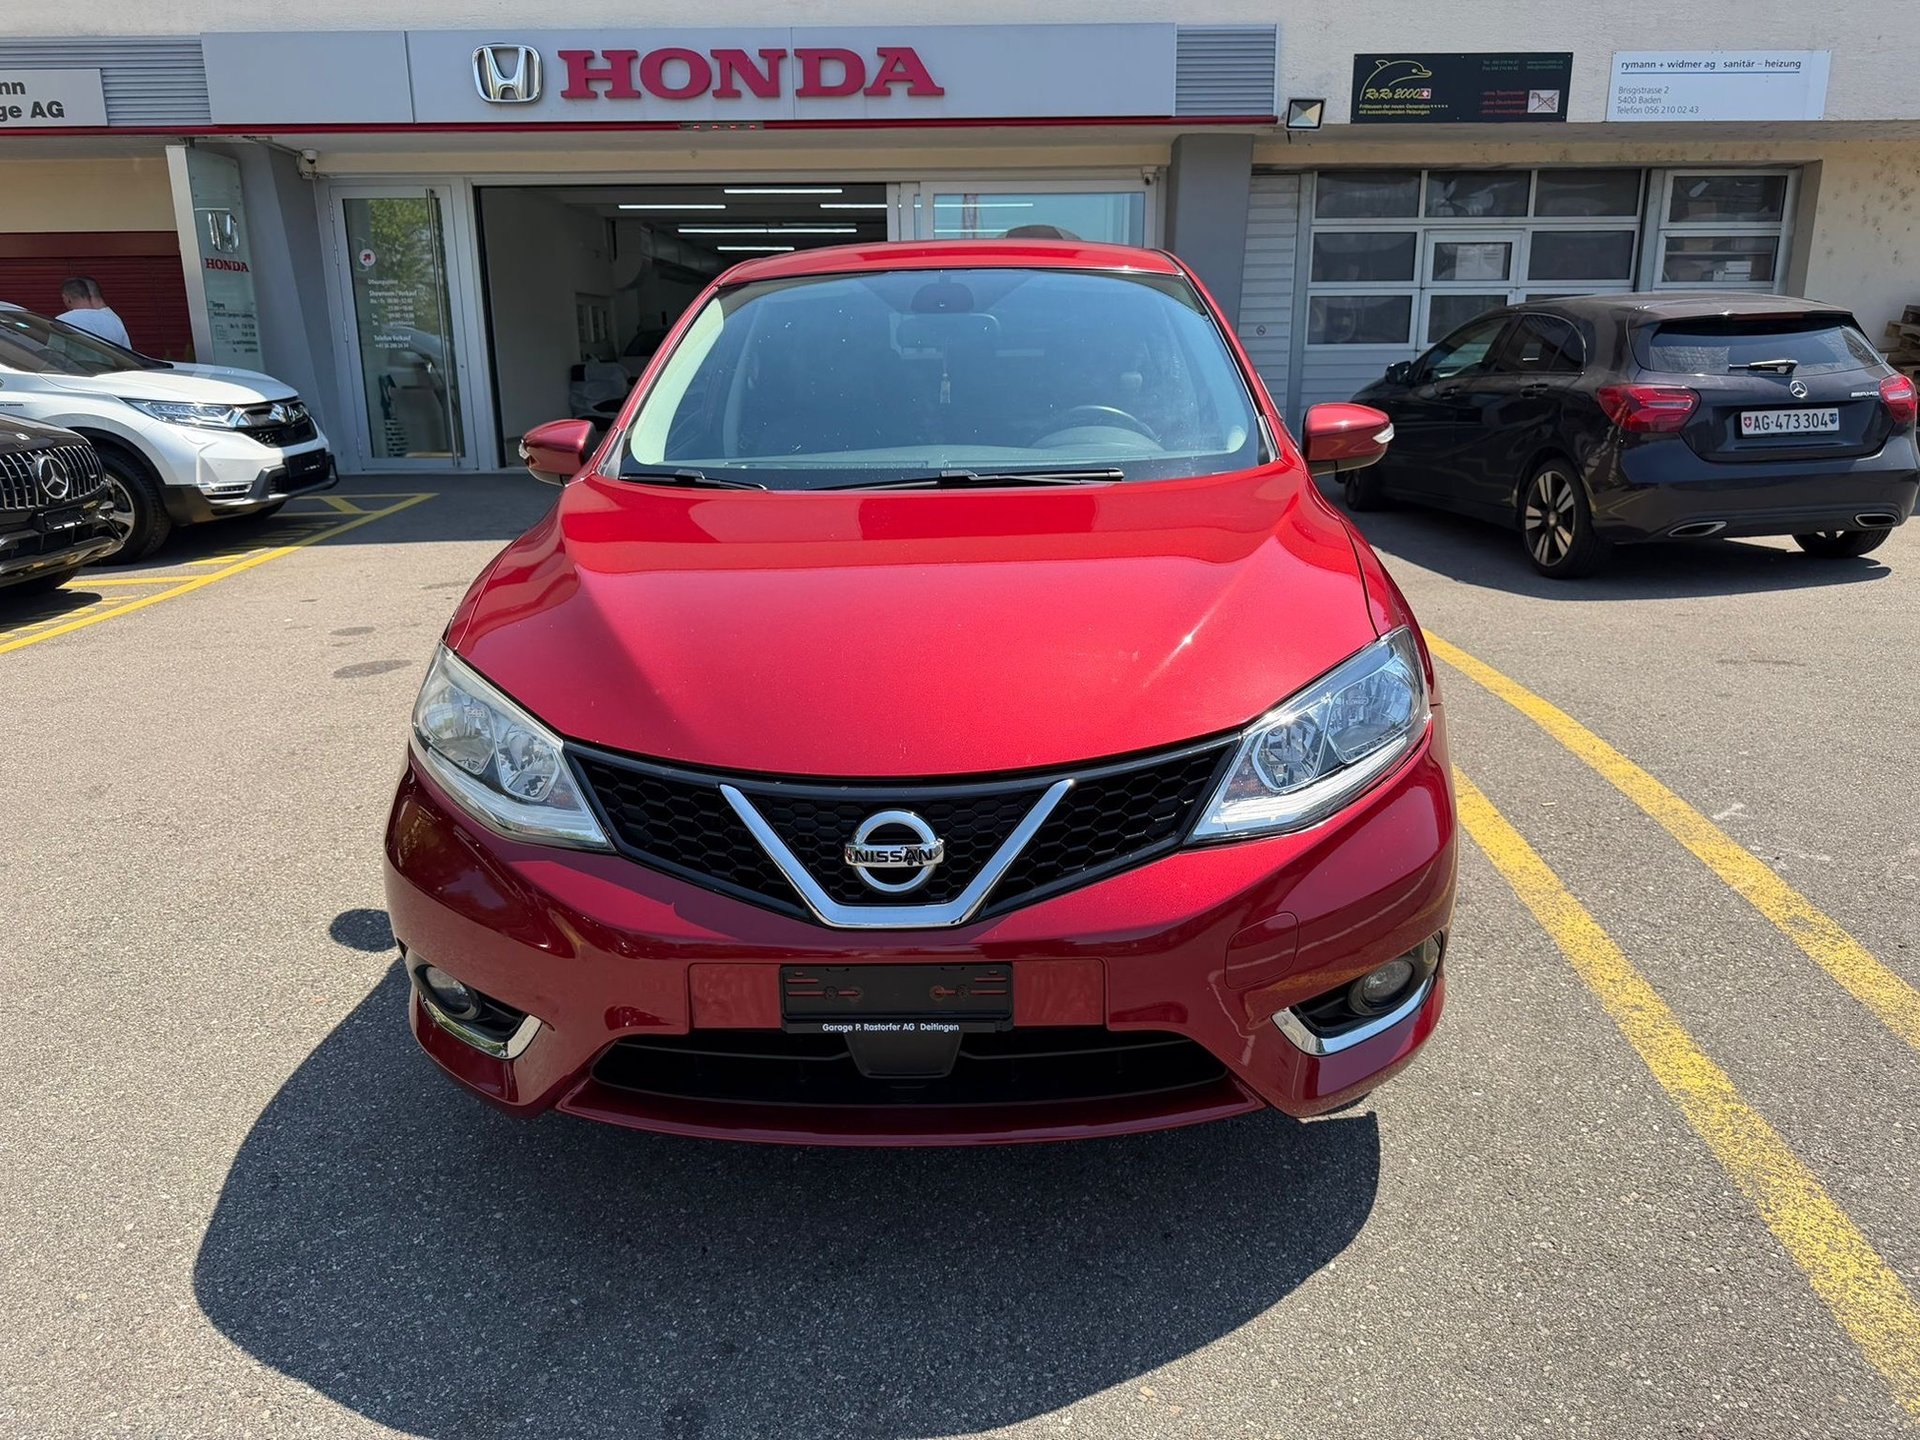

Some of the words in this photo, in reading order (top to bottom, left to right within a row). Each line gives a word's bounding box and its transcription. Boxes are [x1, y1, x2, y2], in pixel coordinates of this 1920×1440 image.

[1621, 61, 1656, 71] rymann
[1667, 59, 1702, 68] widmer
[1703, 61, 1716, 70] ag
[1723, 59, 1755, 68] sanitär
[1764, 59, 1801, 70] heizung
[557, 46, 945, 100] HONDA
[1364, 88, 1393, 100] RoRo
[1393, 87, 1421, 99] 2000
[1664, 86, 1670, 94] 2
[1617, 96, 1637, 104] 5400
[1638, 96, 1662, 104] Baden
[30, 100, 65, 118] AG
[1616, 105, 1643, 114] Telefon
[1644, 106, 1660, 114] 056
[1660, 106, 1676, 114] 210
[1677, 106, 1688, 114] 02
[1689, 105, 1700, 114] 43
[205, 258, 249, 272] HONDA
[854, 848, 933, 863] NISSAN
[822, 1023, 853, 1033] Garage
[855, 1023, 862, 1031] P.
[863, 1023, 901, 1031] Rastorfer
[902, 1023, 915, 1031] AG
[920, 1023, 960, 1033] Deitingen
